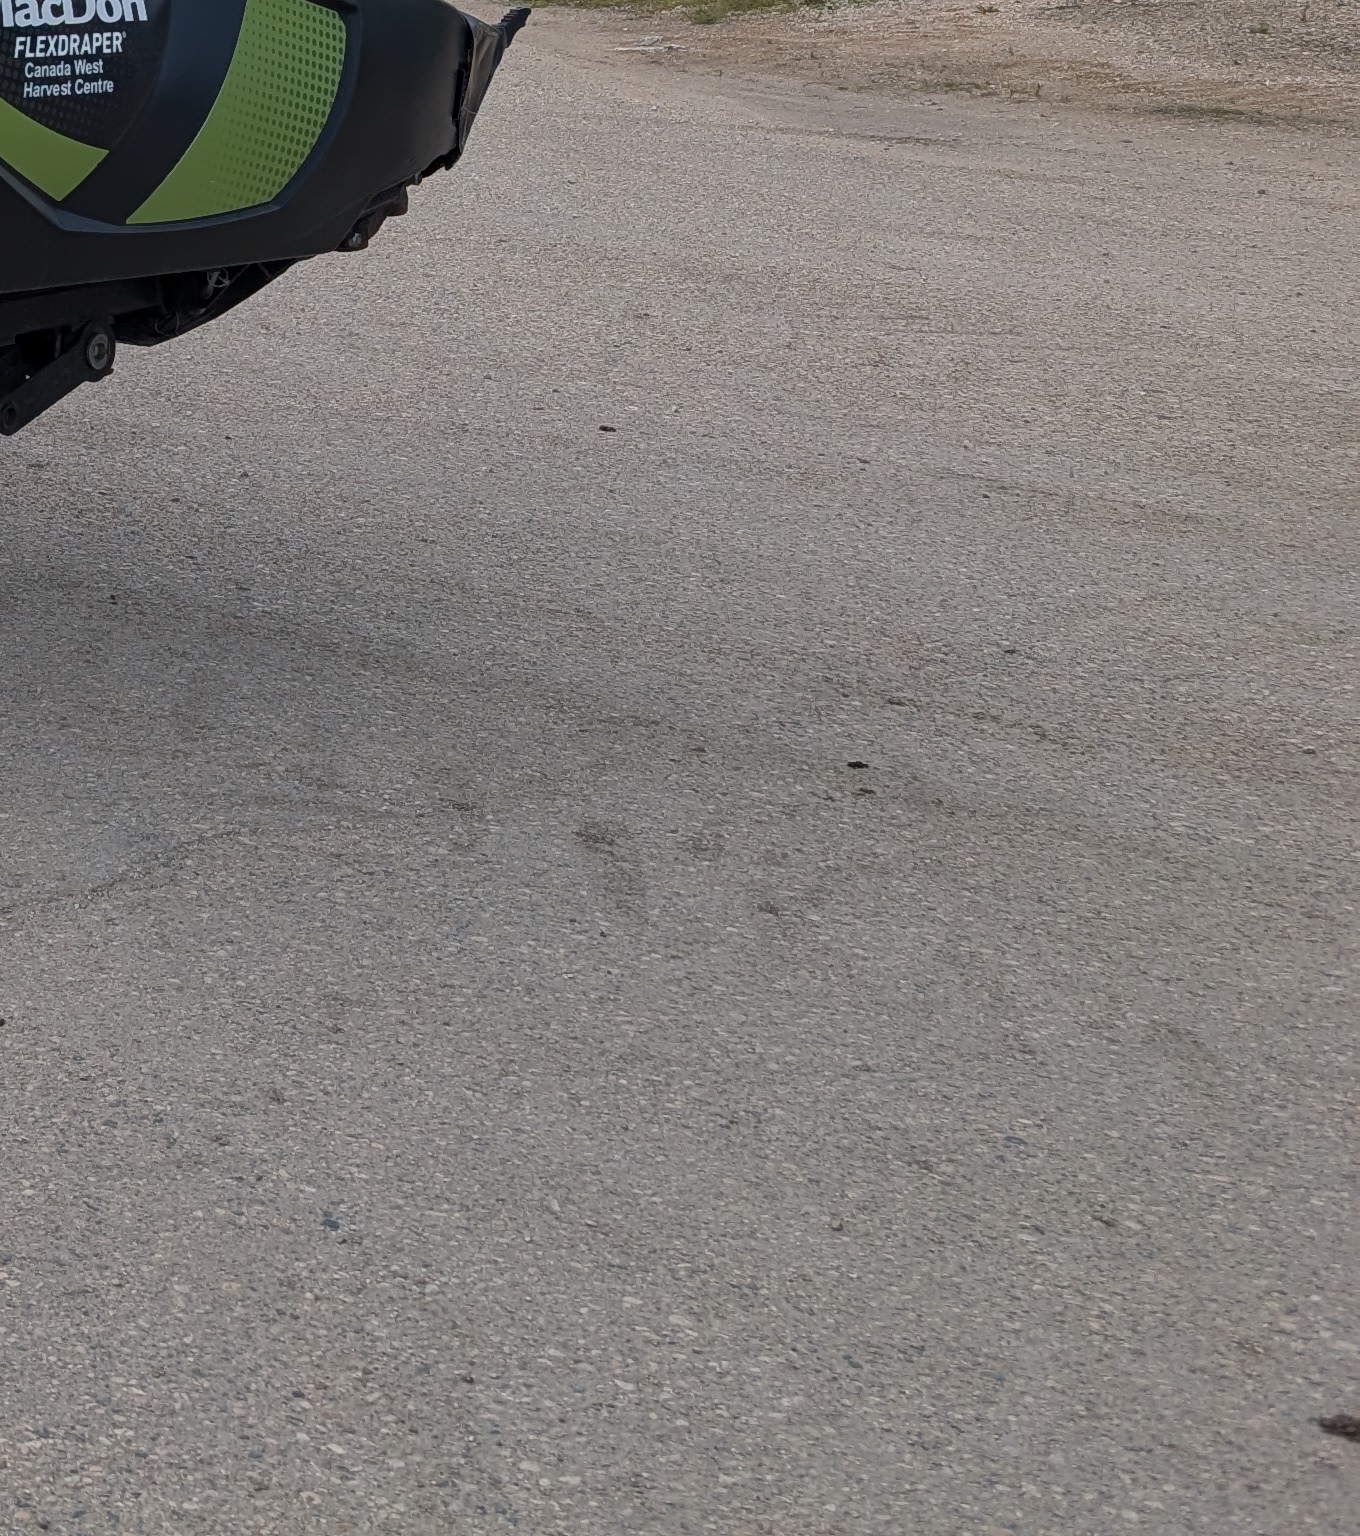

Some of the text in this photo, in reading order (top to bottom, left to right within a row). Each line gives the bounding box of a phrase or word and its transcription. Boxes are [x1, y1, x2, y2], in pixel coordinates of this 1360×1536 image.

[13, 31, 124, 59] FLEXDRAPER
[23, 58, 104, 79] Canada West
[22, 77, 115, 99] Harvest Centre
